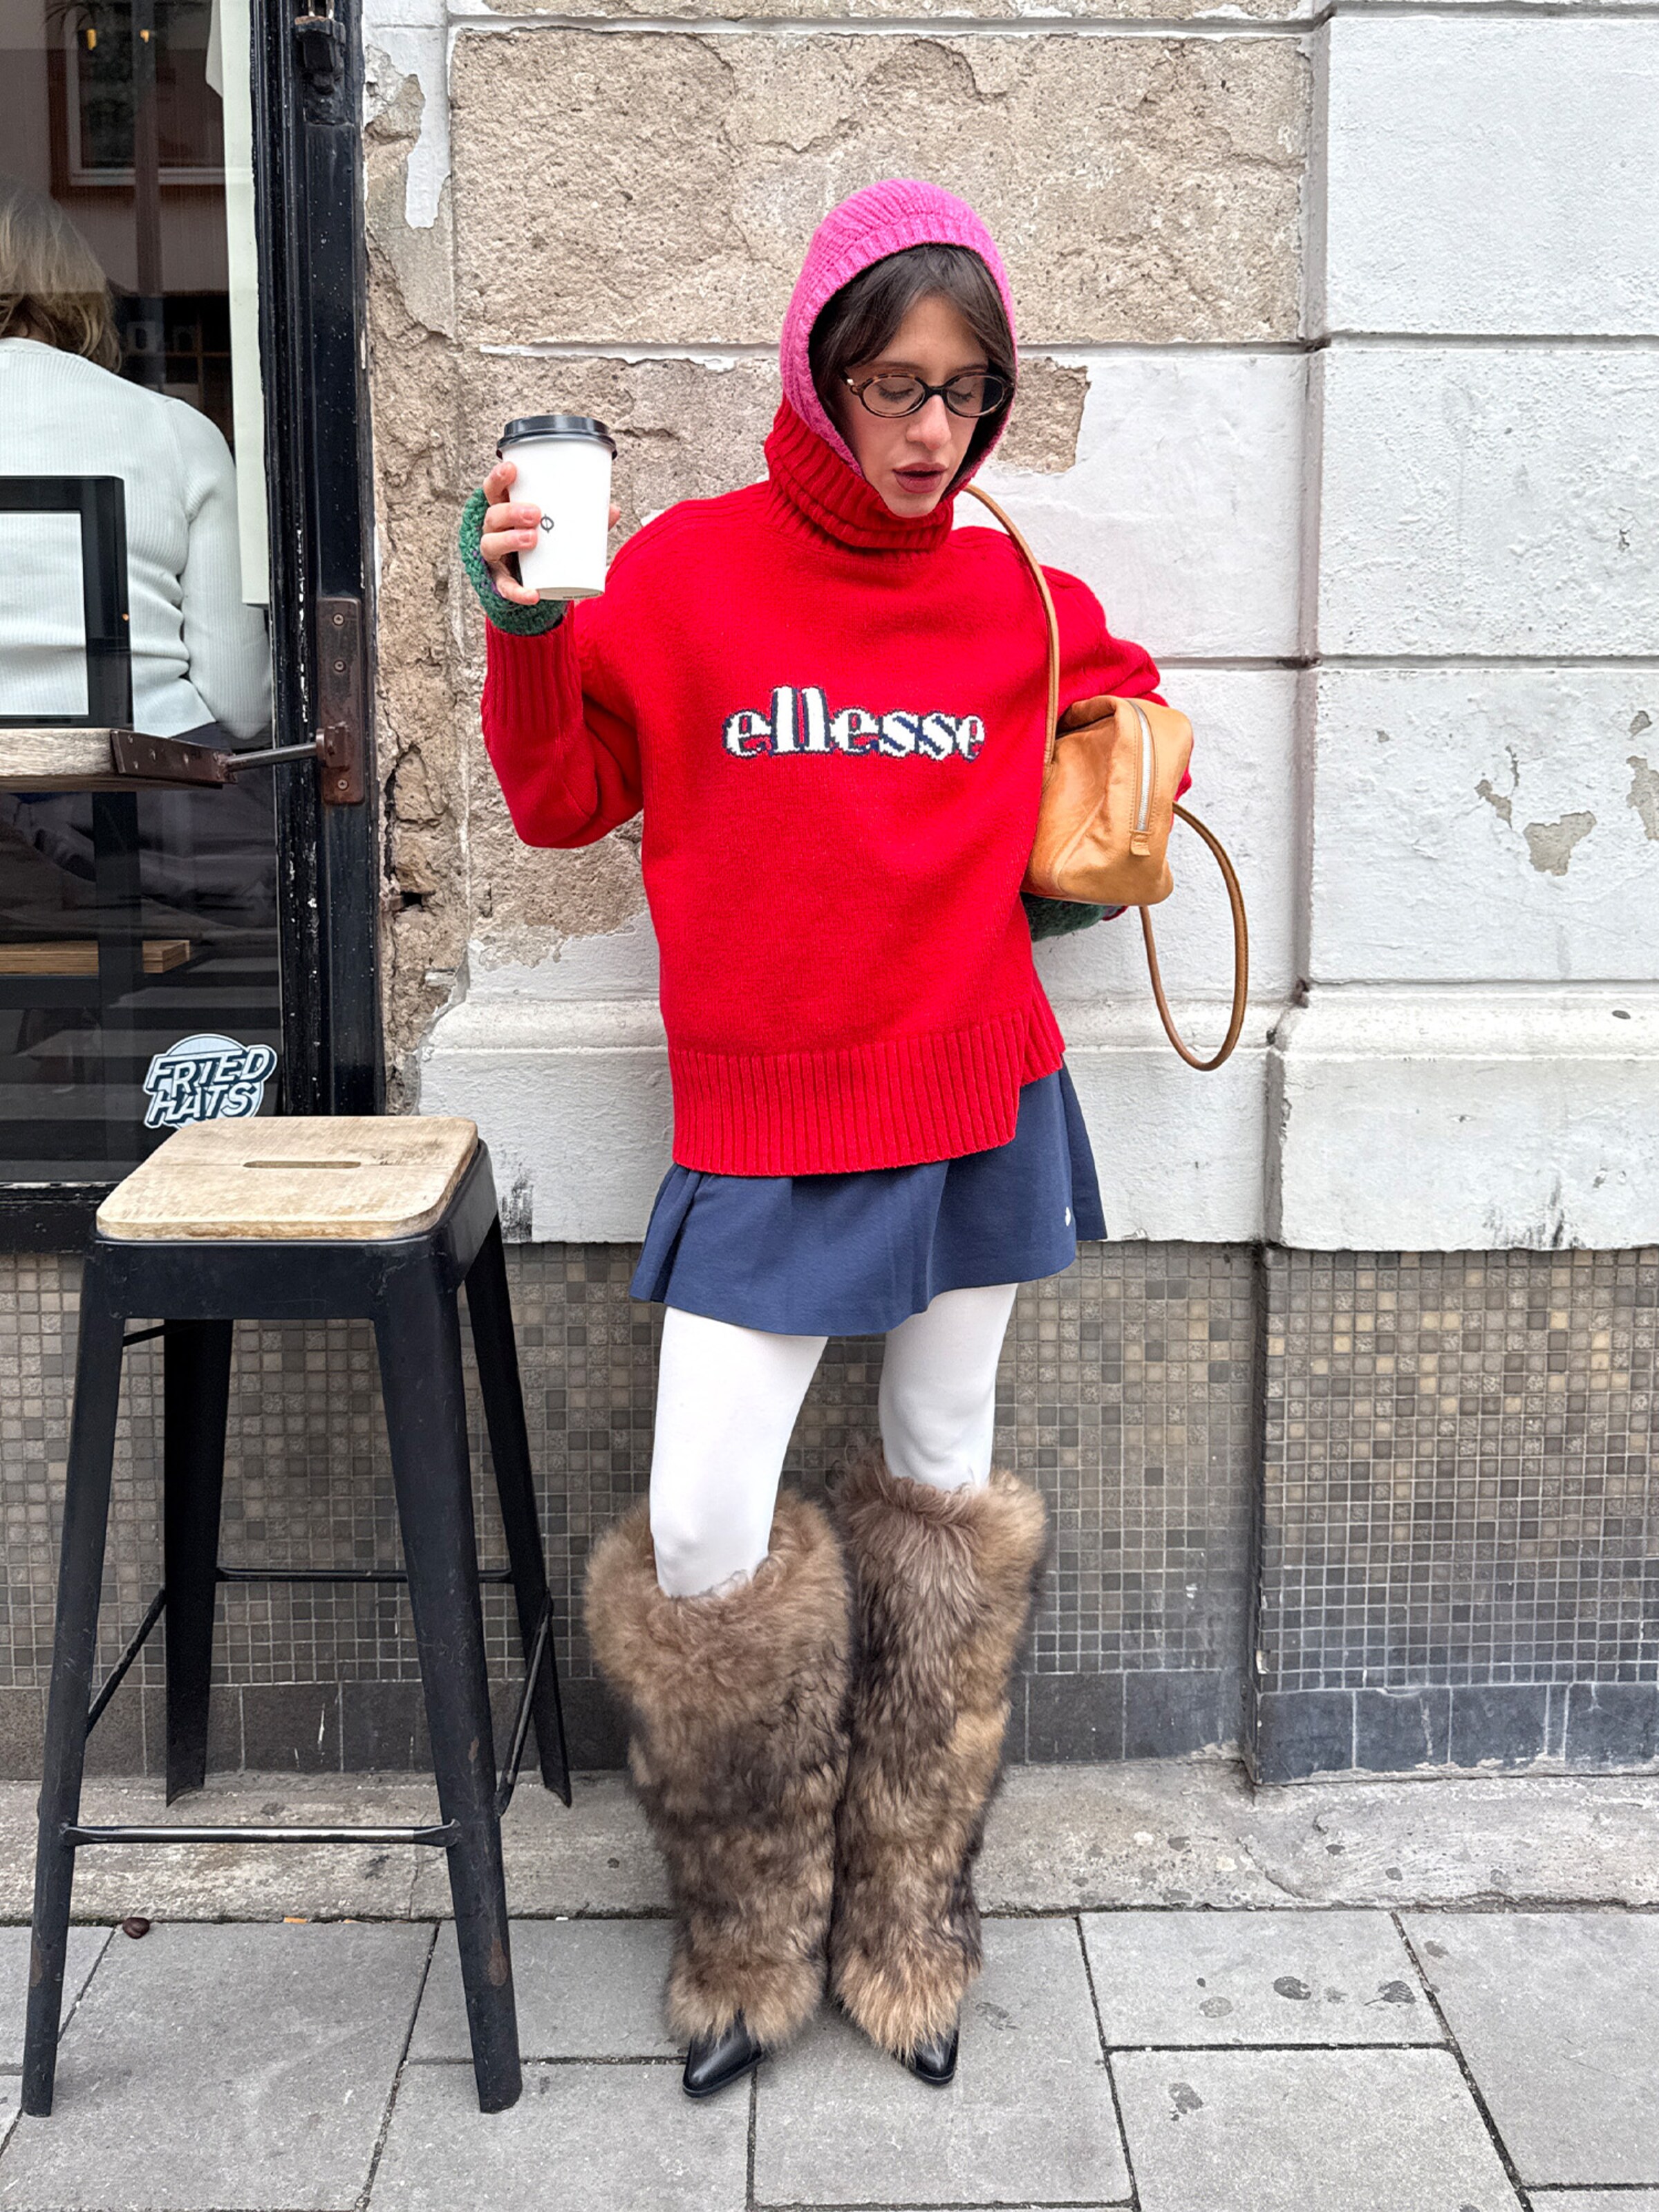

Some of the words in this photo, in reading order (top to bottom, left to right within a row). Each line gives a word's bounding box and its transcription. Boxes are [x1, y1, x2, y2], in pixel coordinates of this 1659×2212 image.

[723, 685, 985, 762] ellesse
[146, 1048, 275, 1099] FRIED
[147, 1081, 257, 1125] HATS
